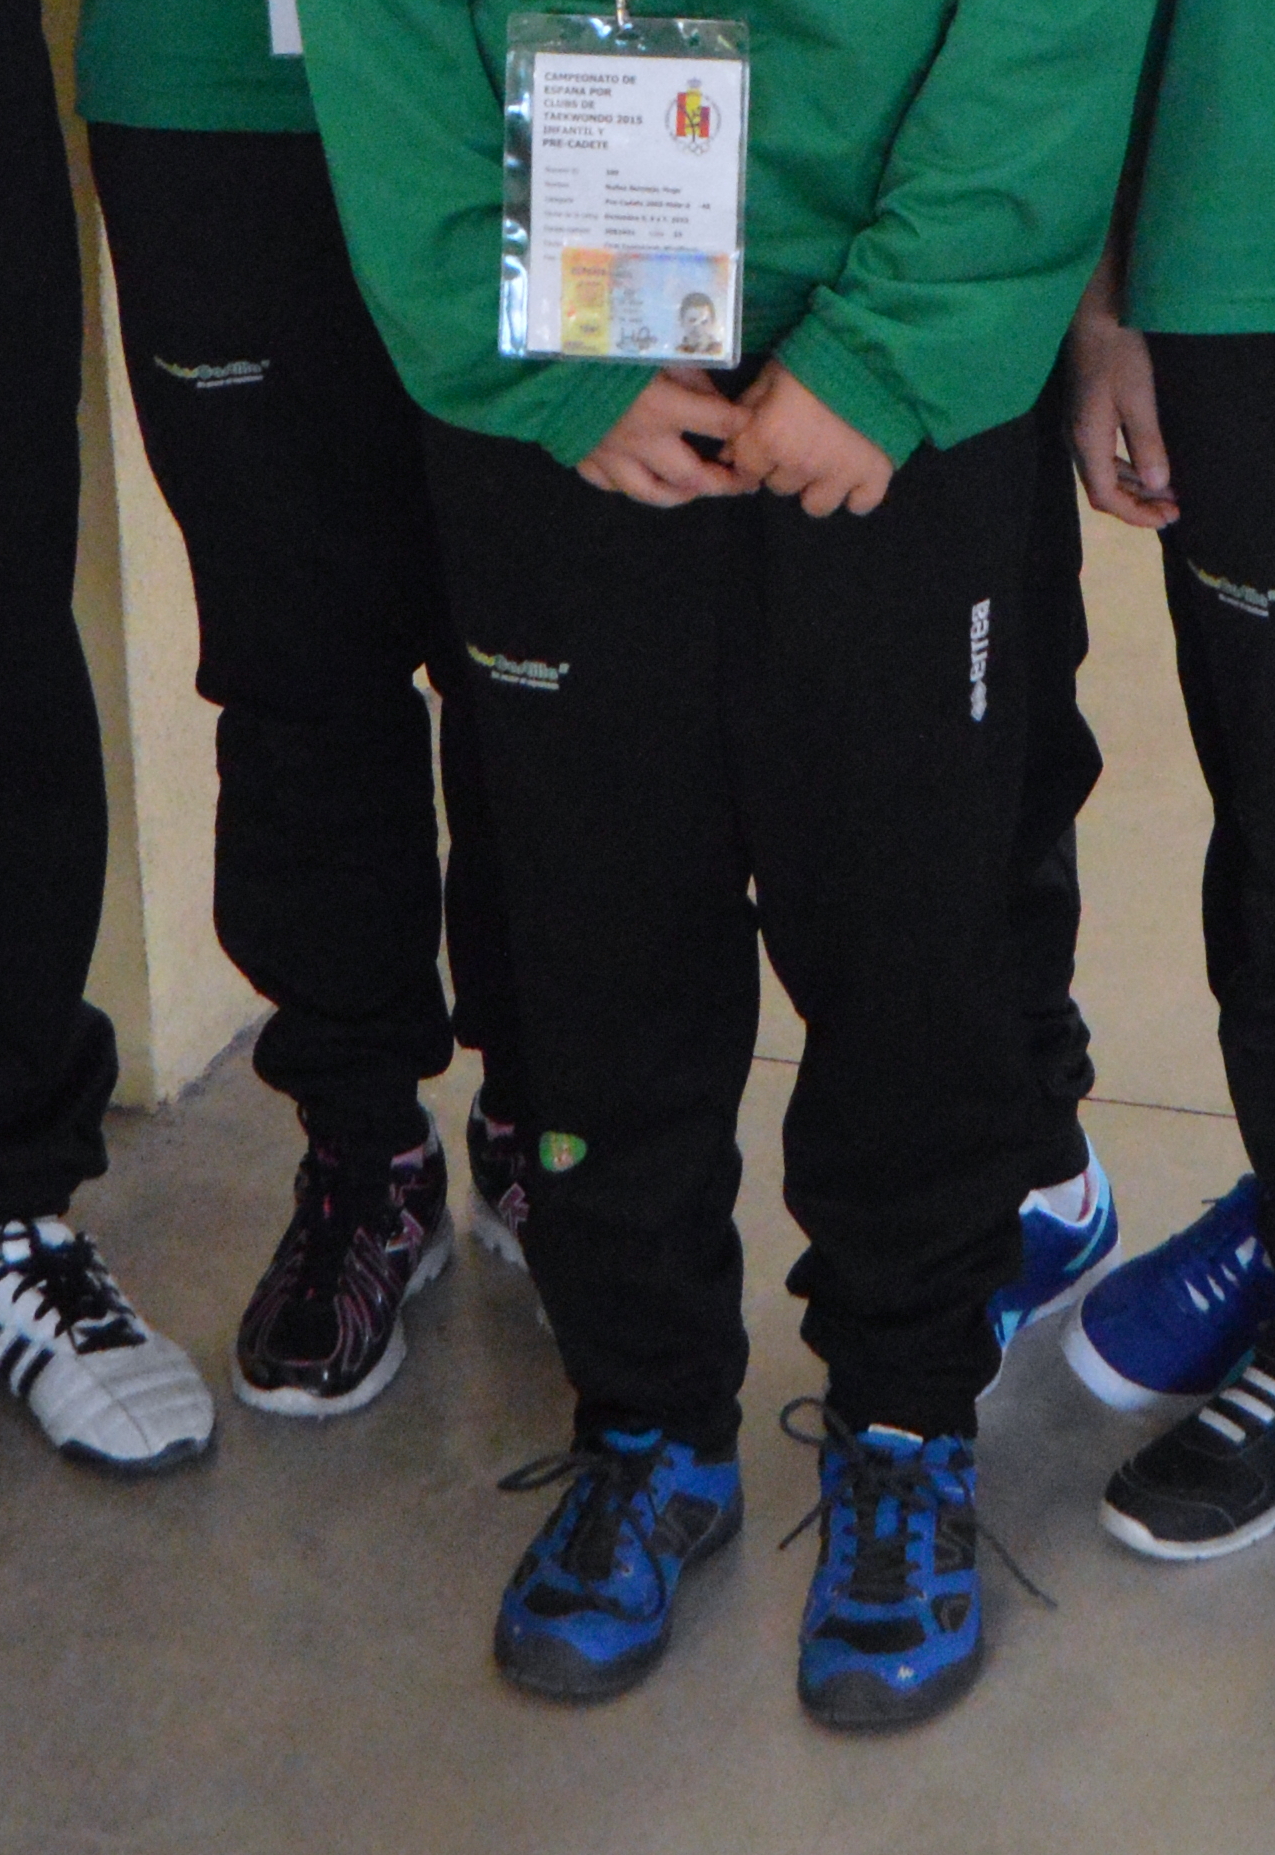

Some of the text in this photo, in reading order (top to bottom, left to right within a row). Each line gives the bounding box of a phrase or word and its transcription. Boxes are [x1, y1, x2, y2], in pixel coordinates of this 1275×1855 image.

[544, 71, 636, 85] CAMPEONATO DE
[589, 88, 611, 97] POR
[543, 98, 594, 109] CLUBS DE
[544, 112, 642, 125] TAEKWONDO 2015
[543, 126, 592, 136] INFANTIL
[970, 598, 991, 682] errea
